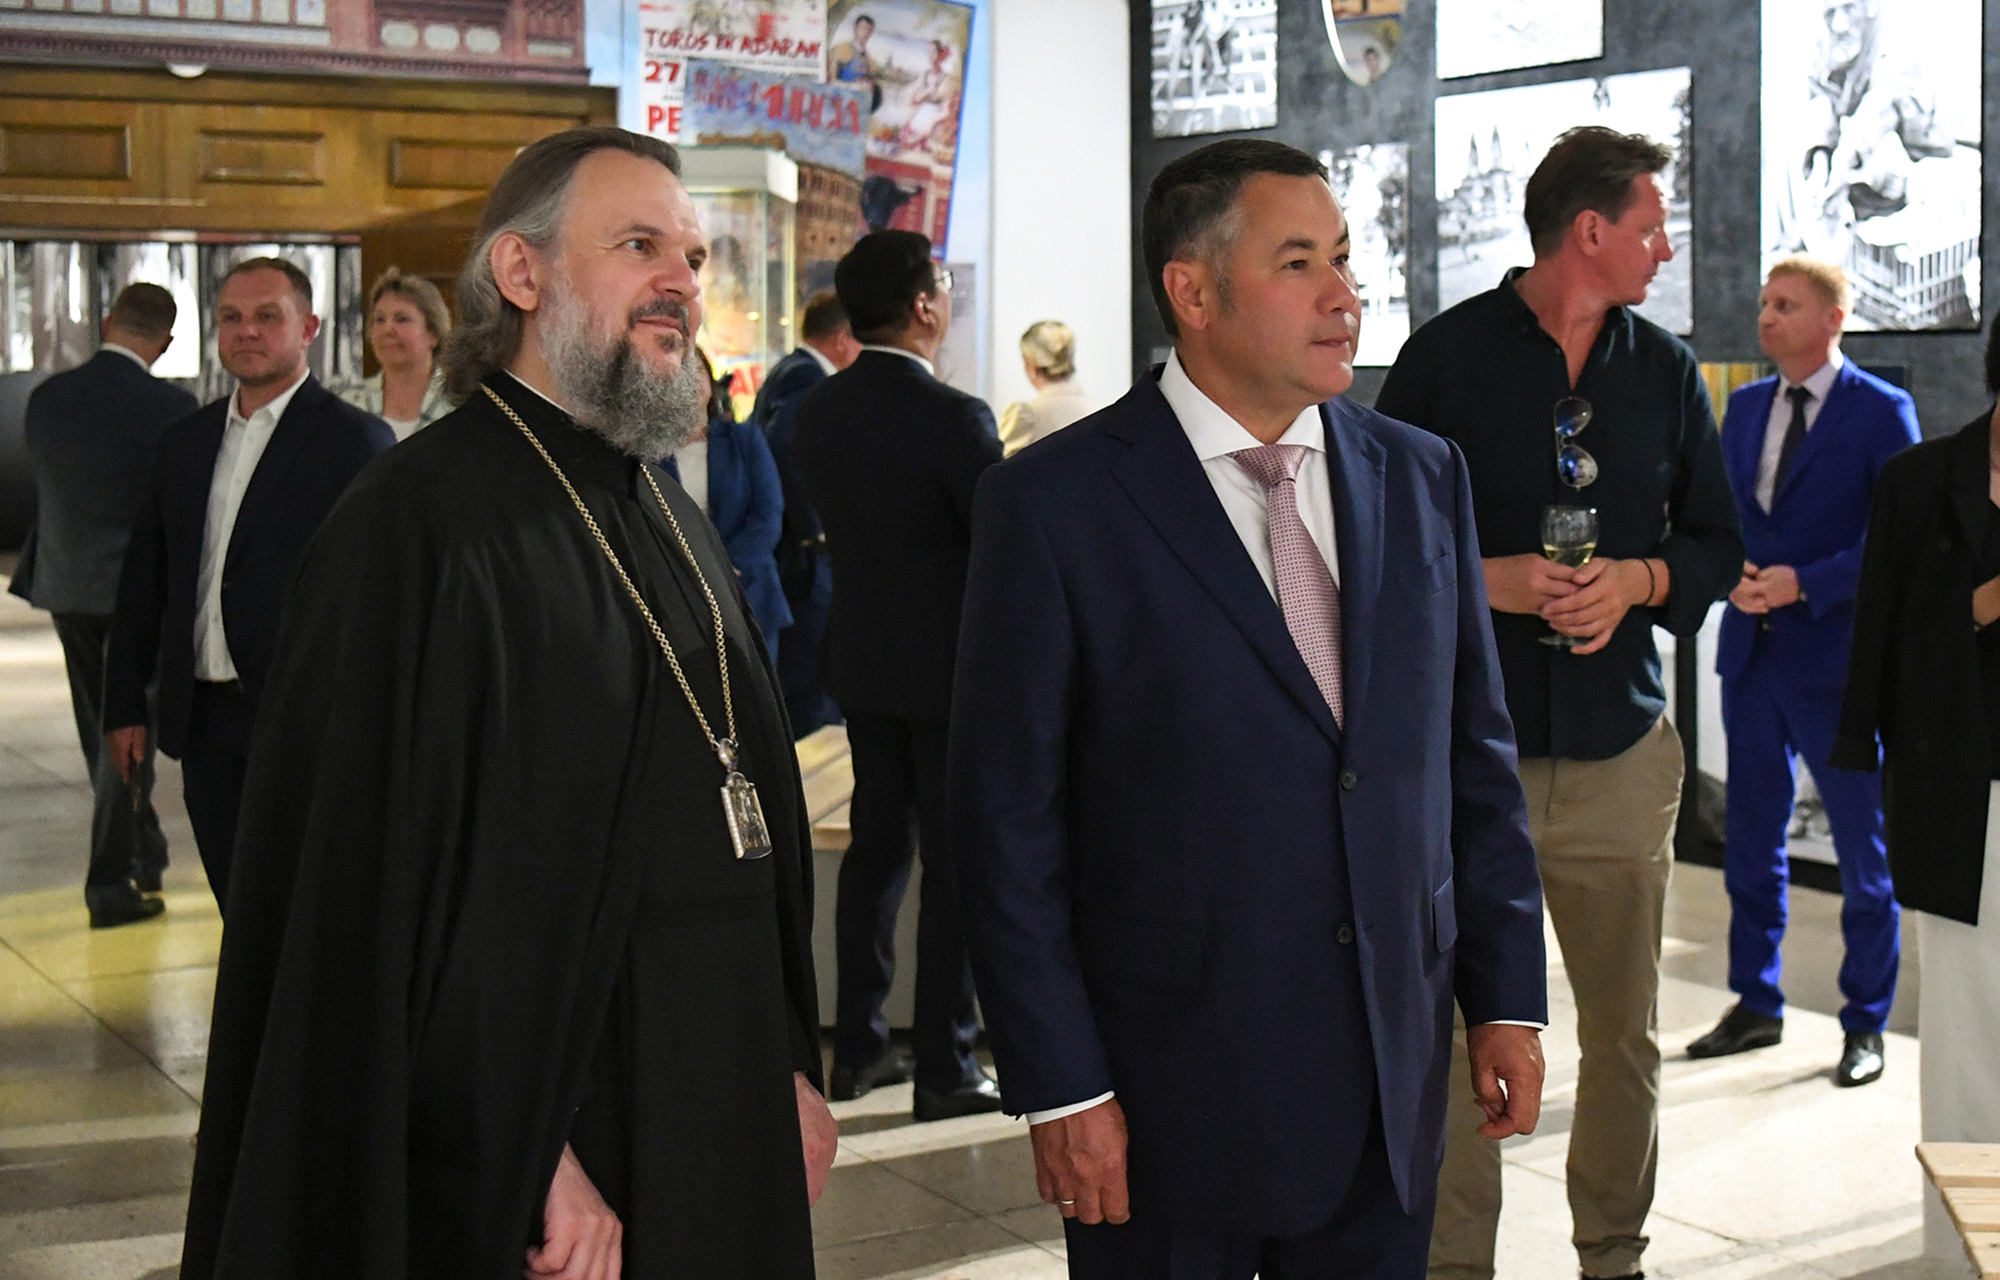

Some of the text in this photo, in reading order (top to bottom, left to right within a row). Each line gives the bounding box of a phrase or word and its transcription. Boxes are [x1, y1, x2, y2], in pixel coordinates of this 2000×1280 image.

[644, 27, 709, 51] TOROS
[645, 60, 681, 83] 27
[648, 105, 682, 134] PE
